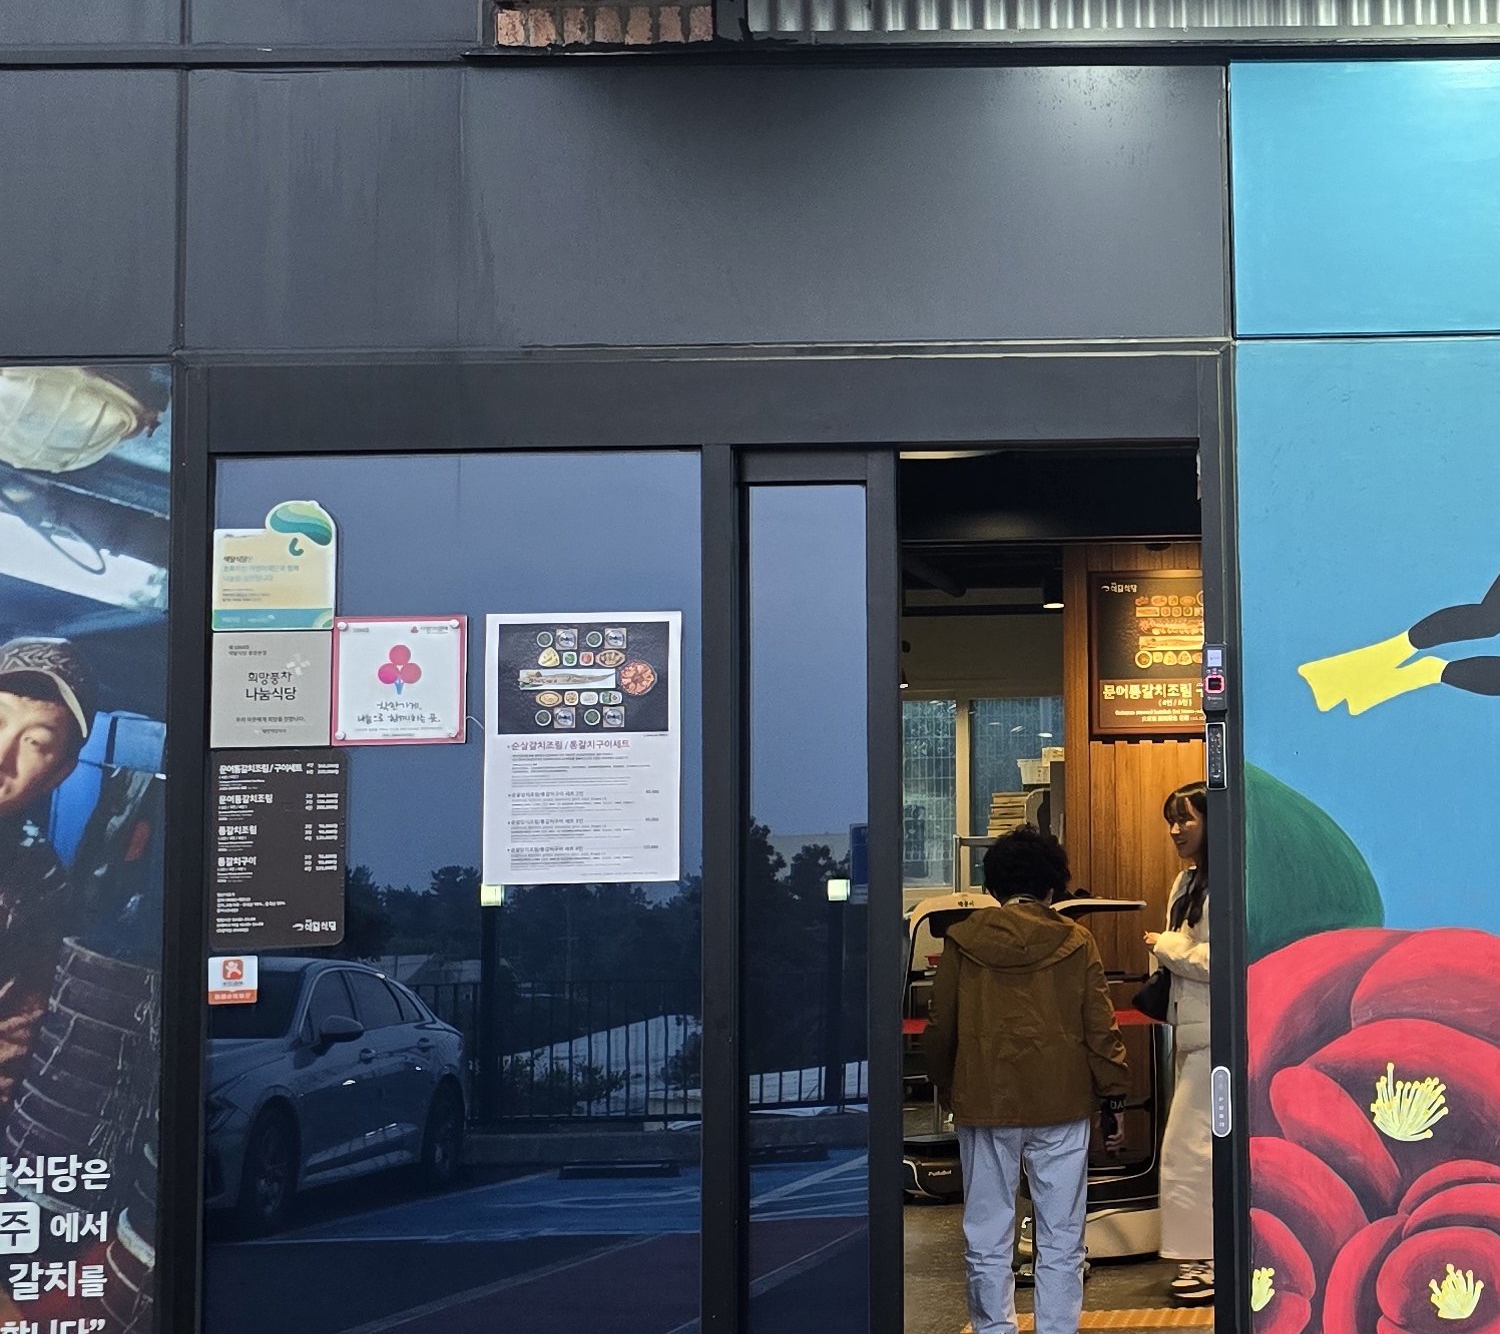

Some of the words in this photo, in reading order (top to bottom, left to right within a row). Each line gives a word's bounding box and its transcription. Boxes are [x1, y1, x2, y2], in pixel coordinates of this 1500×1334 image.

[248, 671, 293, 686] 희망풍차
[245, 686, 298, 702] 나눔식당
[50, 1211, 109, 1243] 에서
[8, 1260, 108, 1301] 갈치를
